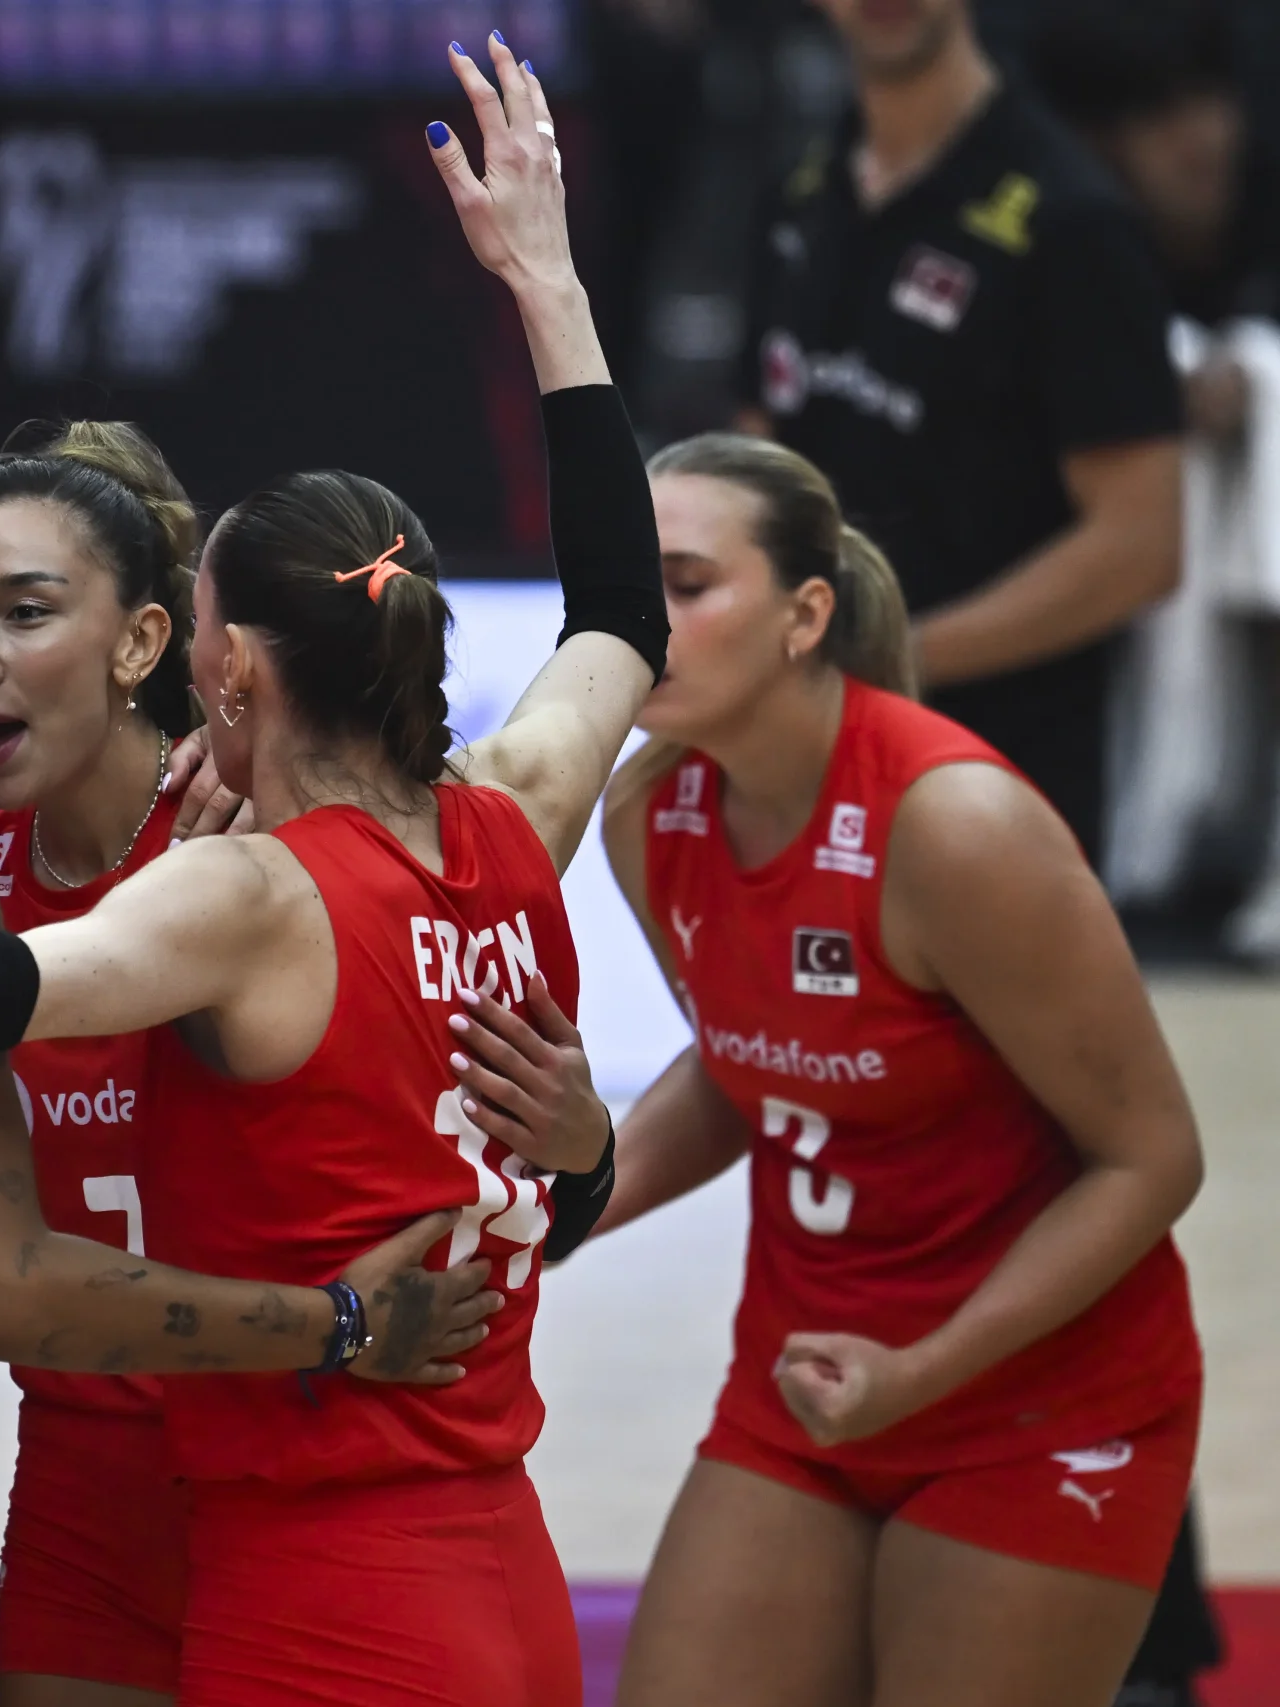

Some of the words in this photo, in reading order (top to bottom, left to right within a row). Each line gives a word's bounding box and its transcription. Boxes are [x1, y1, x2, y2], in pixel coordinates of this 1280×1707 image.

[705, 1024, 887, 1083] vodafone
[40, 1078, 136, 1126] voda
[434, 1084, 557, 1290] 14
